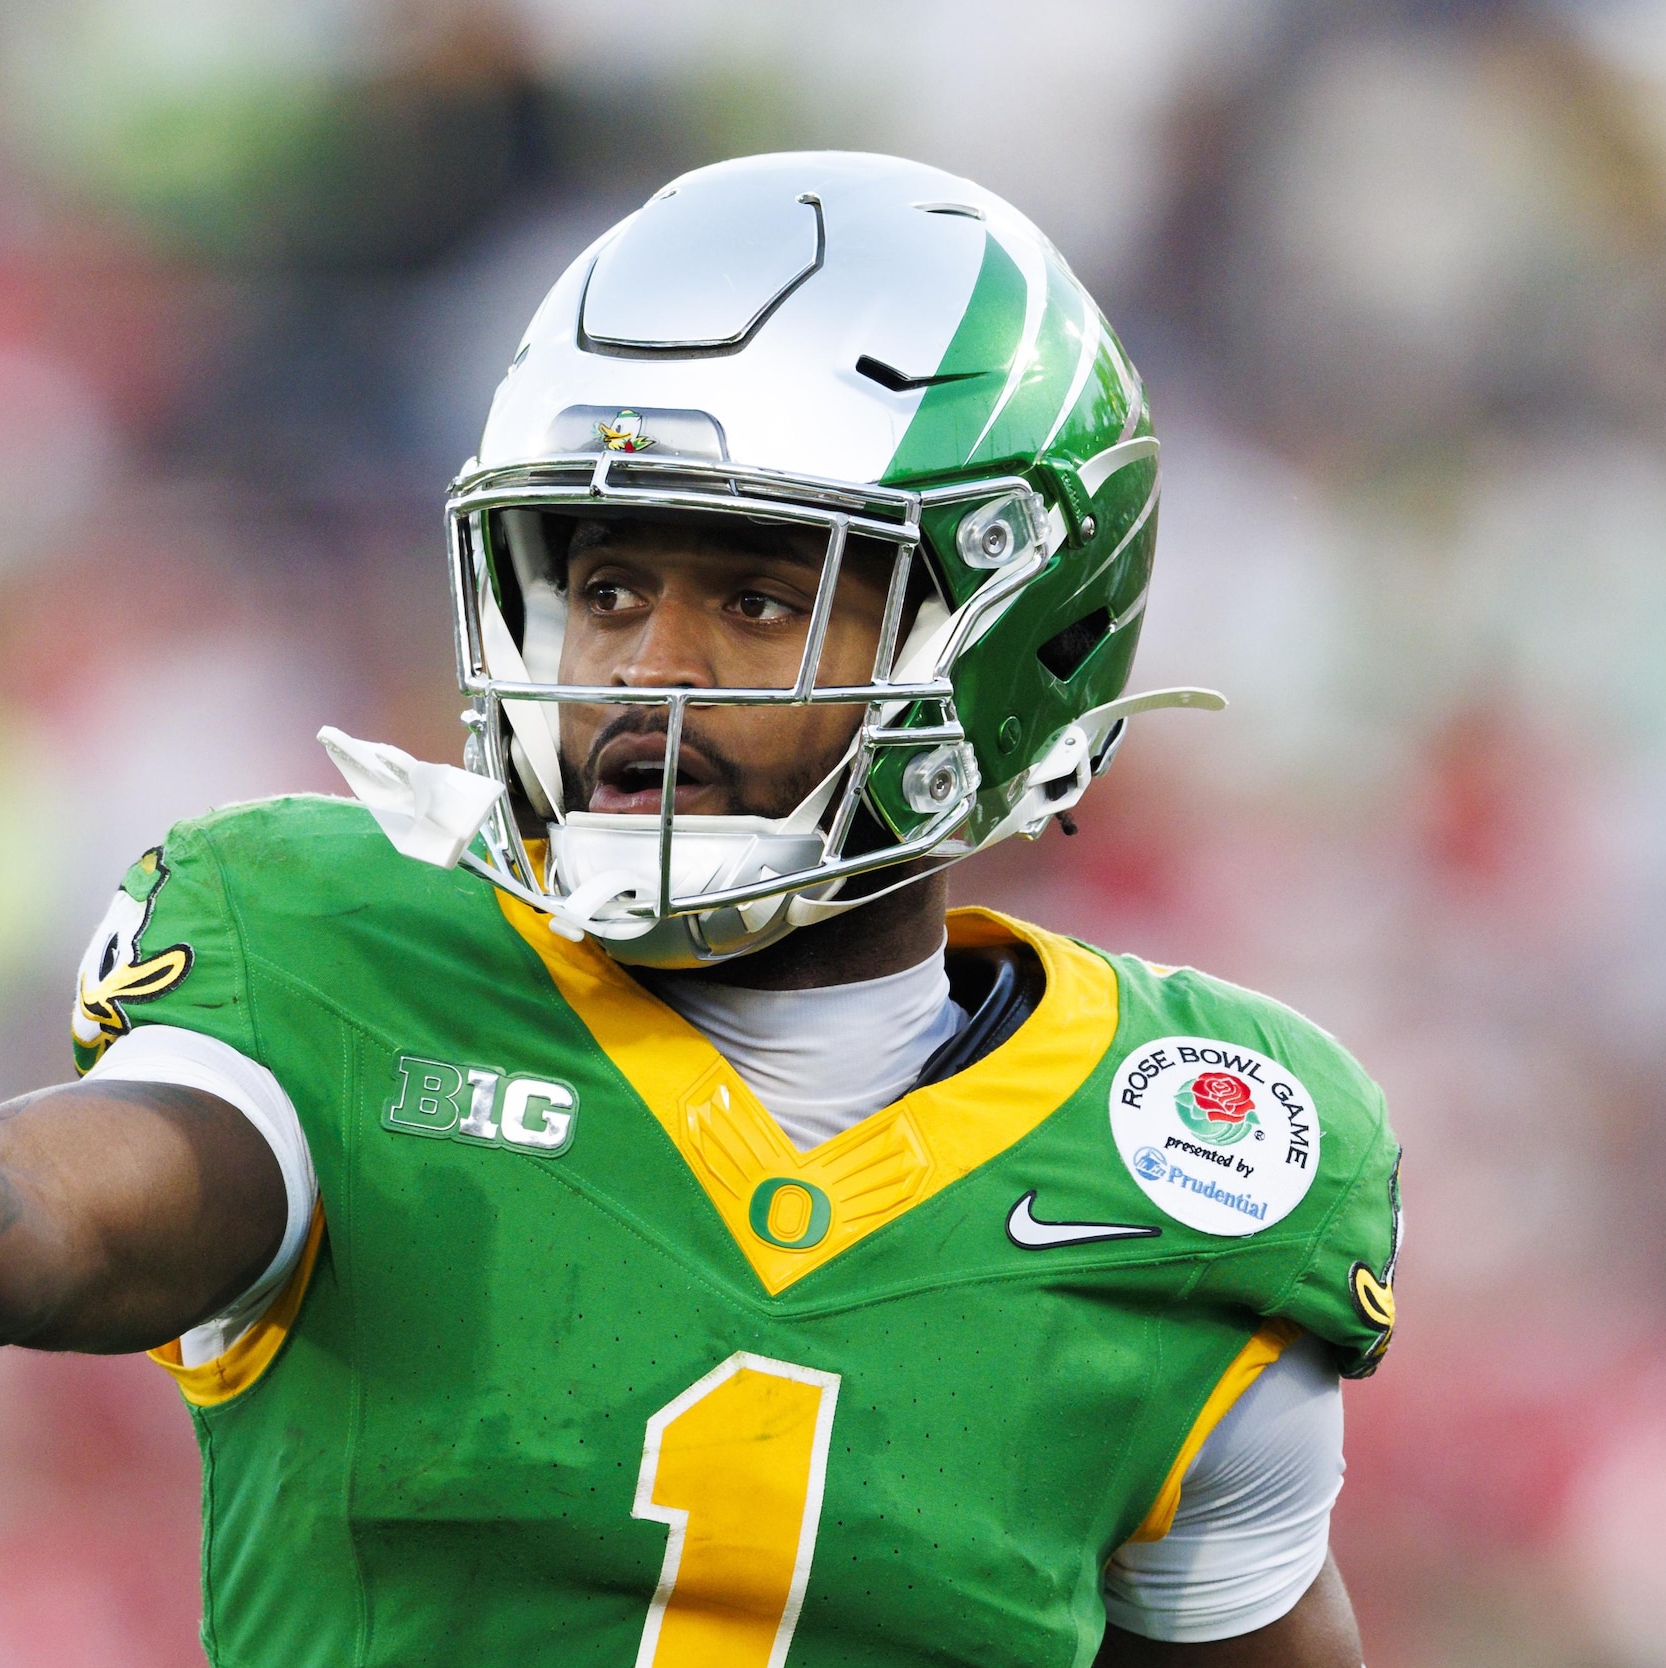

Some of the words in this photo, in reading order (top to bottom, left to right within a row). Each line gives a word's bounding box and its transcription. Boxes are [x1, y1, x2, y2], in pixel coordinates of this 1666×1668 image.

[1121, 1049, 1175, 1110] ROSE
[1177, 1046, 1266, 1084] BOWL
[1271, 1082, 1310, 1169] GAME
[1164, 1135, 1235, 1168] presented
[1236, 1158, 1255, 1179] by
[1166, 1164, 1269, 1221] Prudential
